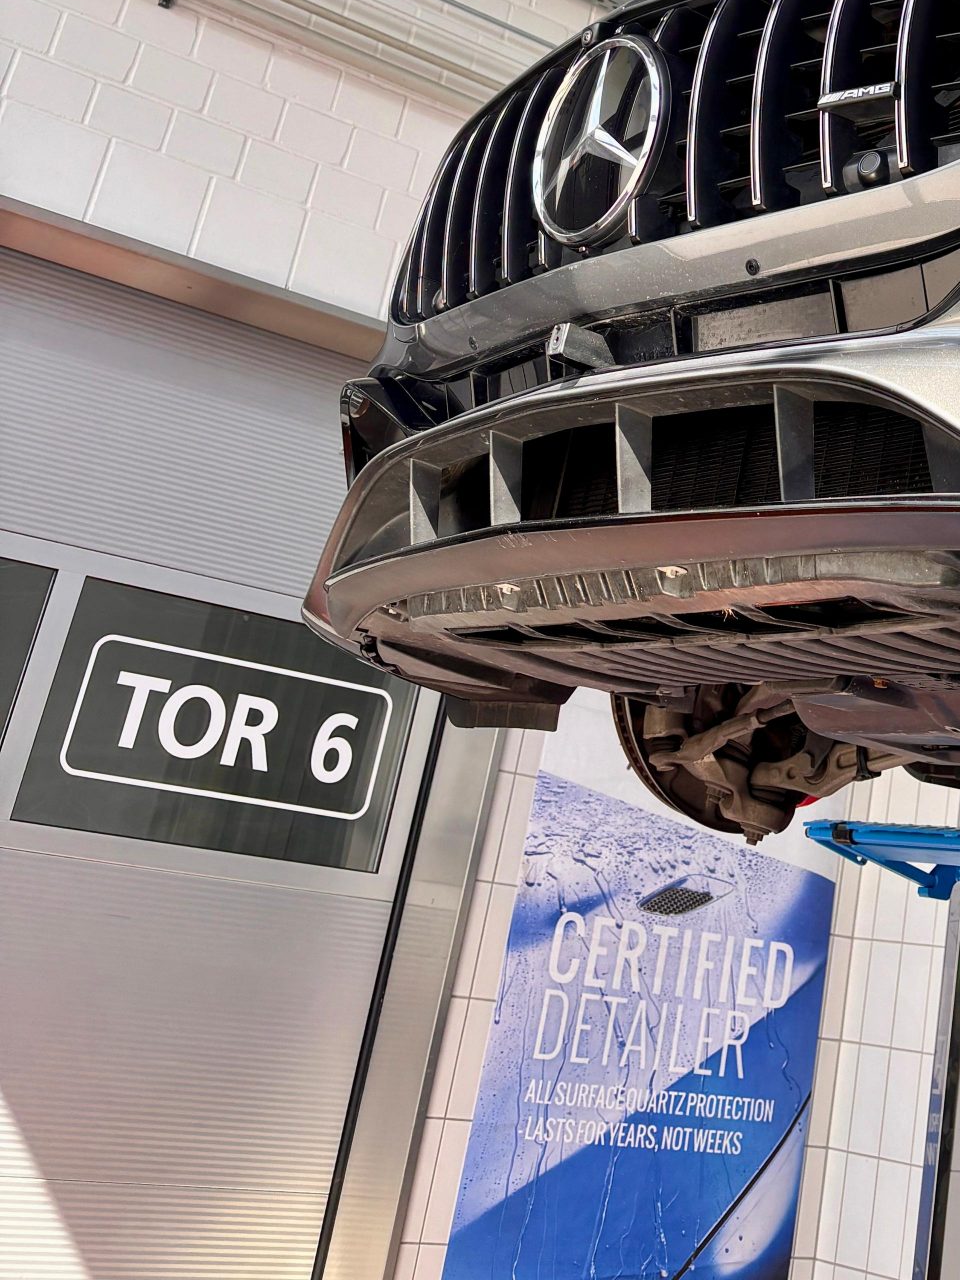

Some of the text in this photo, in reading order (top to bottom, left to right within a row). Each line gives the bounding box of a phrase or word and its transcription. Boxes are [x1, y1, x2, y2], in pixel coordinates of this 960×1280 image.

[840, 83, 891, 101] AMG
[116, 670, 360, 784] TOR 6
[548, 911, 796, 1009] CERTIFIED
[532, 988, 751, 1080] DETAILER
[524, 1079, 775, 1123] ALL SURFACE QUARTZ PROTECTION
[575, 1120, 608, 1146] FOR
[609, 1122, 659, 1152] YEARS,
[660, 1125, 694, 1152] NOT
[693, 1128, 743, 1156] WEEKS
